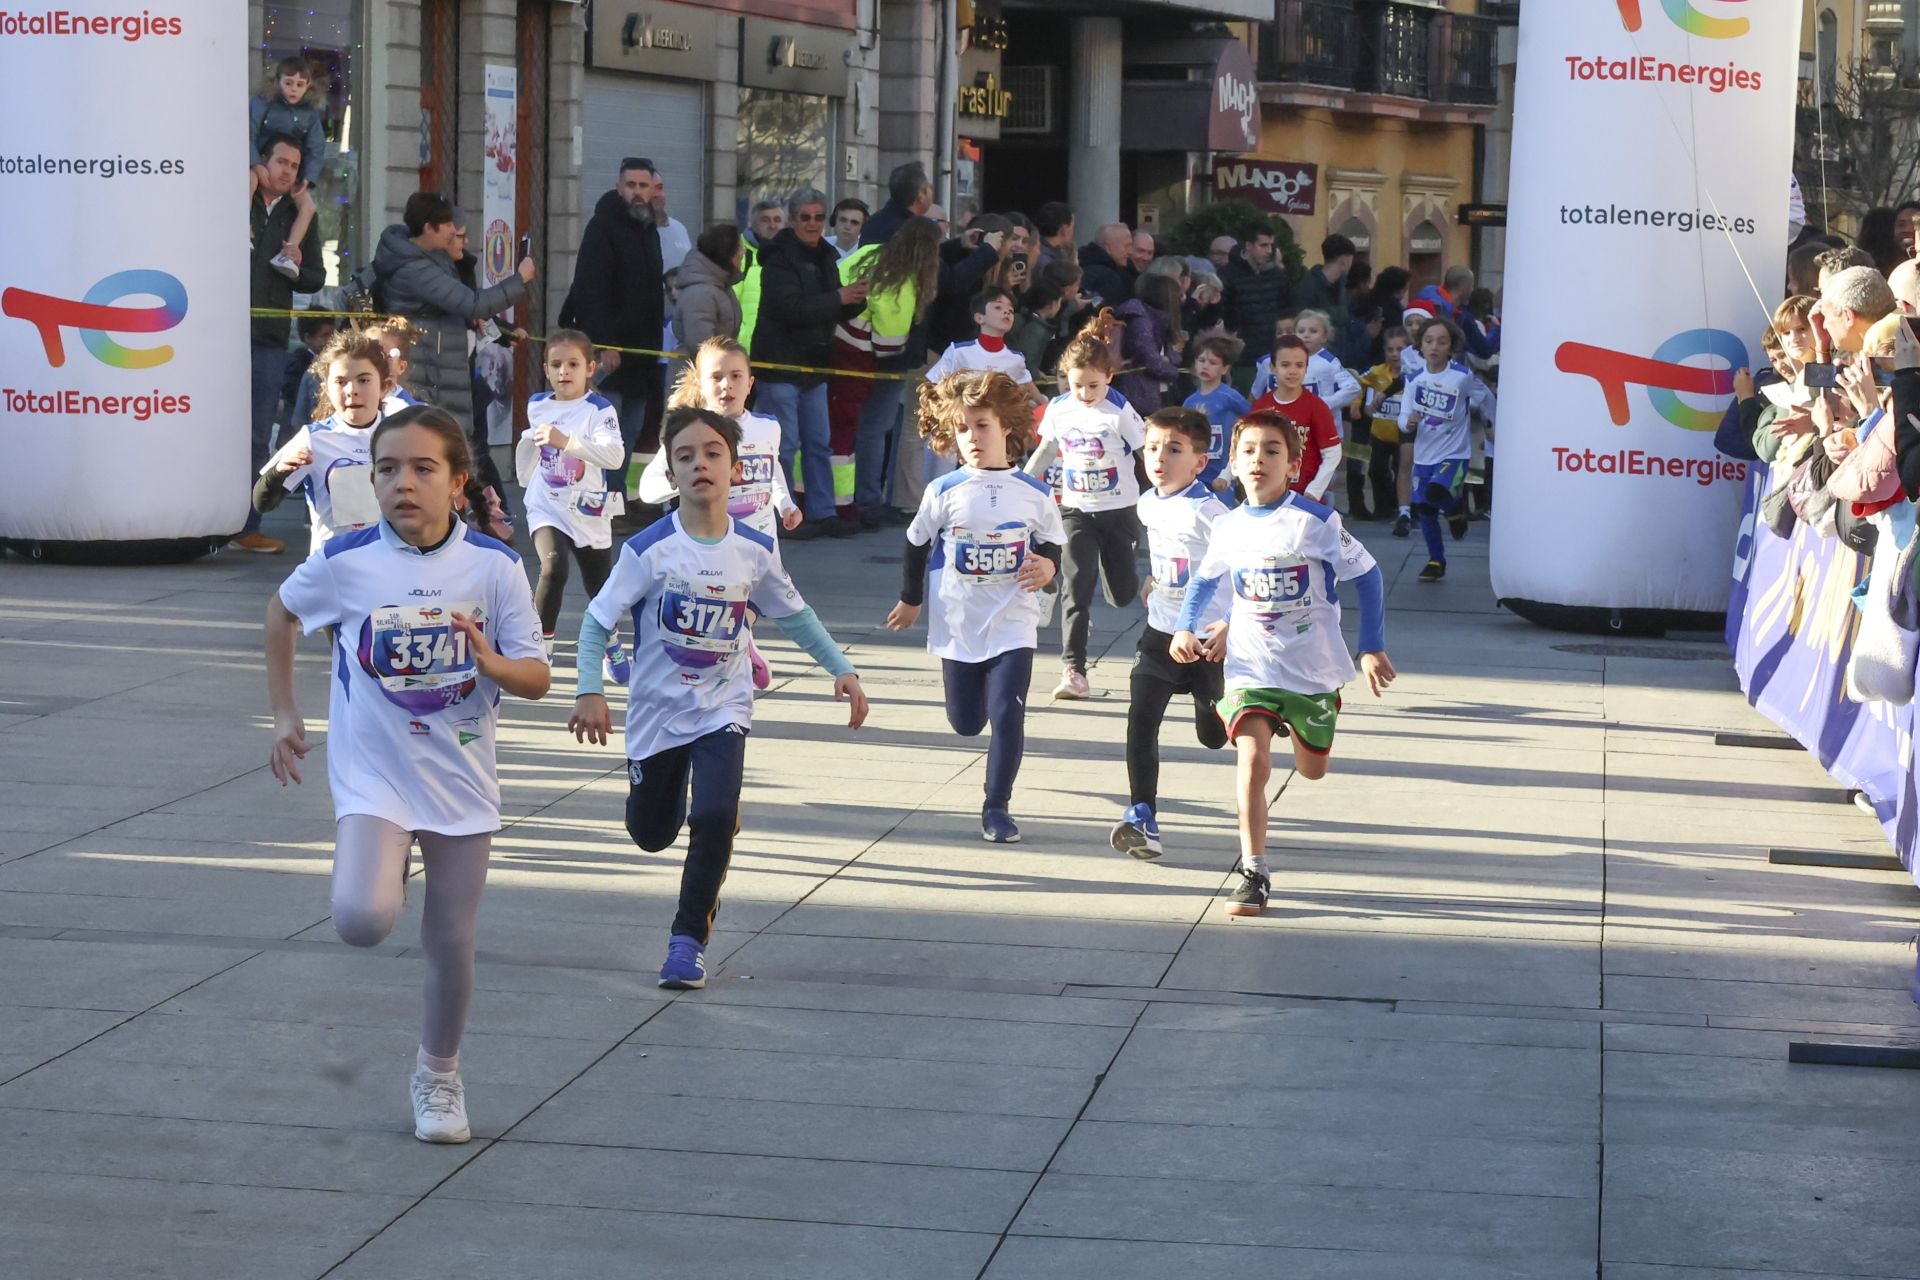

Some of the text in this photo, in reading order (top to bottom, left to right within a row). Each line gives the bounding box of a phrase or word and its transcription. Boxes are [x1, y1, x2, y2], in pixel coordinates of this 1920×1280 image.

[0, 11, 182, 42] TotalEnergies
[1565, 56, 1762, 94] TotalEnergies
[0, 153, 185, 179] totalenergies.es
[1216, 164, 1301, 196] MUNDO
[1560, 203, 1755, 235] totalenergies.es
[3, 389, 192, 421] TotalEnergies
[1552, 447, 1747, 486] TotalEnergies
[964, 546, 1018, 571] 3565
[1241, 570, 1300, 599] 3655
[676, 600, 736, 635] 3174
[390, 631, 467, 670] 3341
